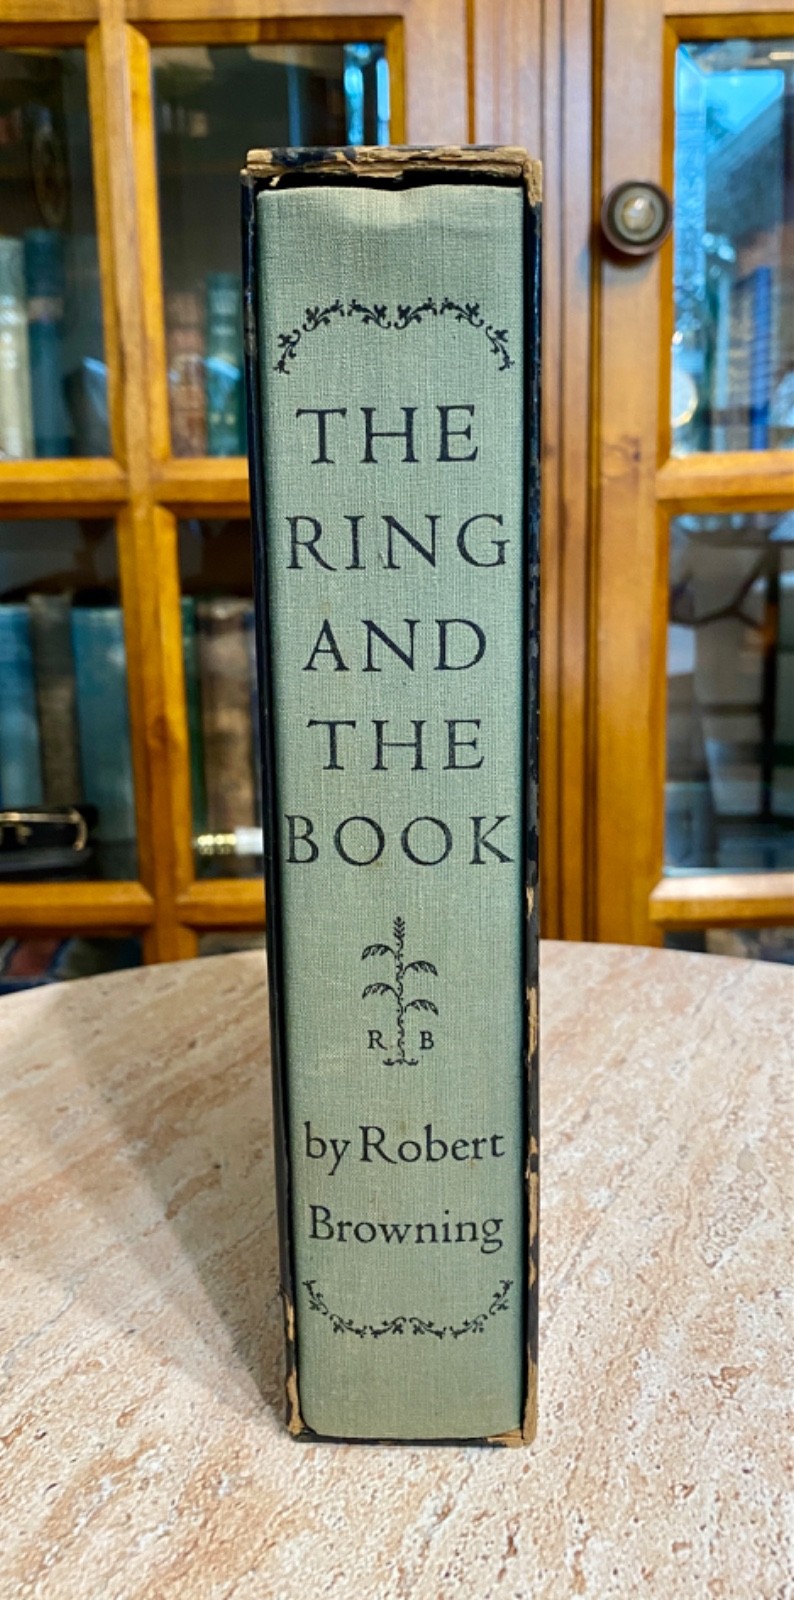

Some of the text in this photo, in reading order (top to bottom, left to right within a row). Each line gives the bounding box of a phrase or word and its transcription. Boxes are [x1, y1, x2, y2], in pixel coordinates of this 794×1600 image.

[296, 405, 479, 464] THE
[286, 514, 509, 571] RING
[303, 619, 487, 672] AND
[307, 719, 485, 771] THE
[284, 814, 513, 867] BOOK
[367, 1029, 435, 1051] R B
[304, 1121, 505, 1176] by Robert
[308, 1205, 504, 1254] Browning
